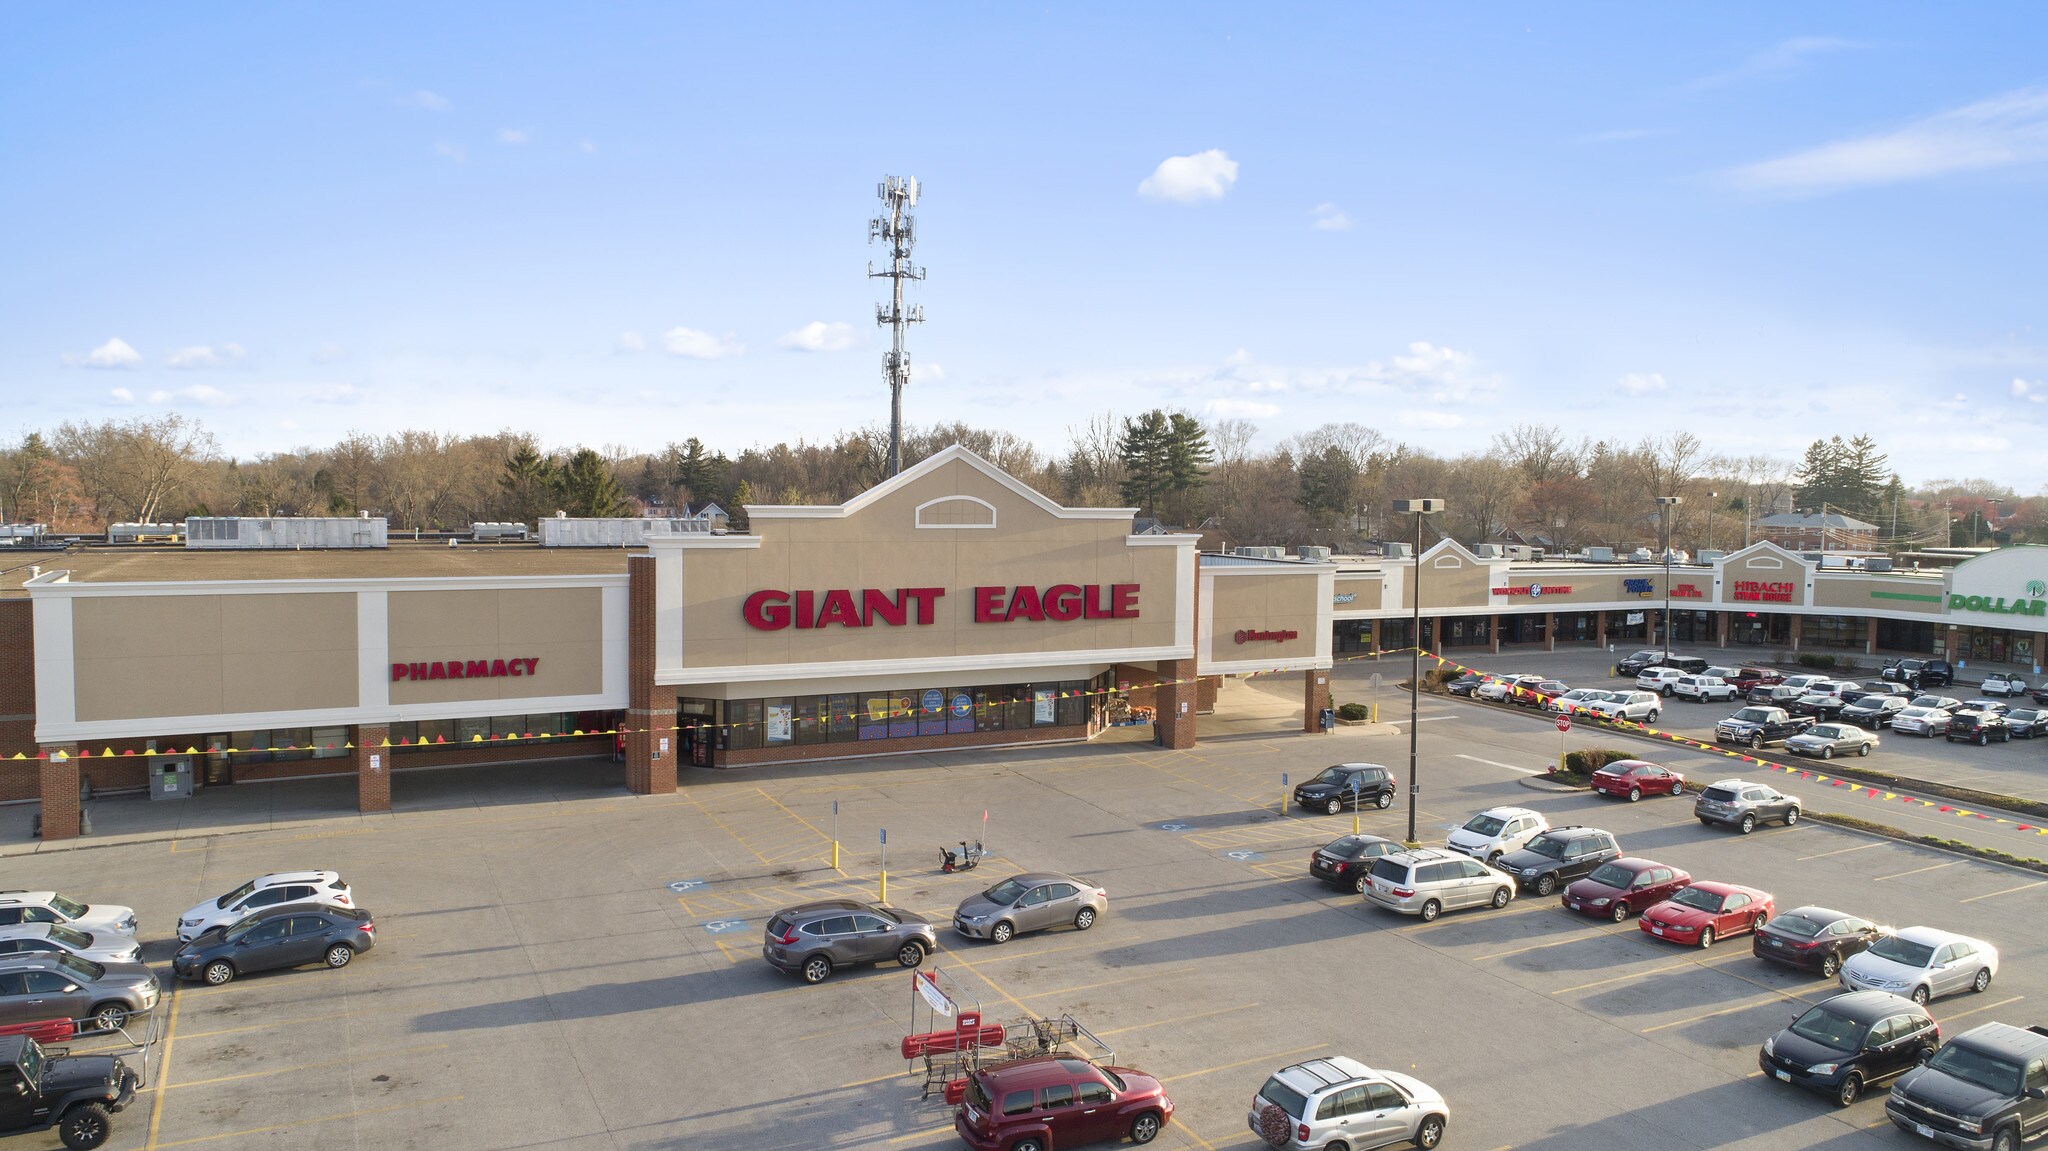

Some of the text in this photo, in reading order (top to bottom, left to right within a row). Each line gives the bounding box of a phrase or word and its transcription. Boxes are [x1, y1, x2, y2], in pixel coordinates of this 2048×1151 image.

[1734, 580, 1795, 593] HIBACHI
[1734, 591, 1792, 602] STEAK HOUSE
[743, 584, 1140, 631] GIANT EAGLE
[1947, 594, 2047, 616] DOLLAR
[392, 658, 540, 682] PHARMACY
